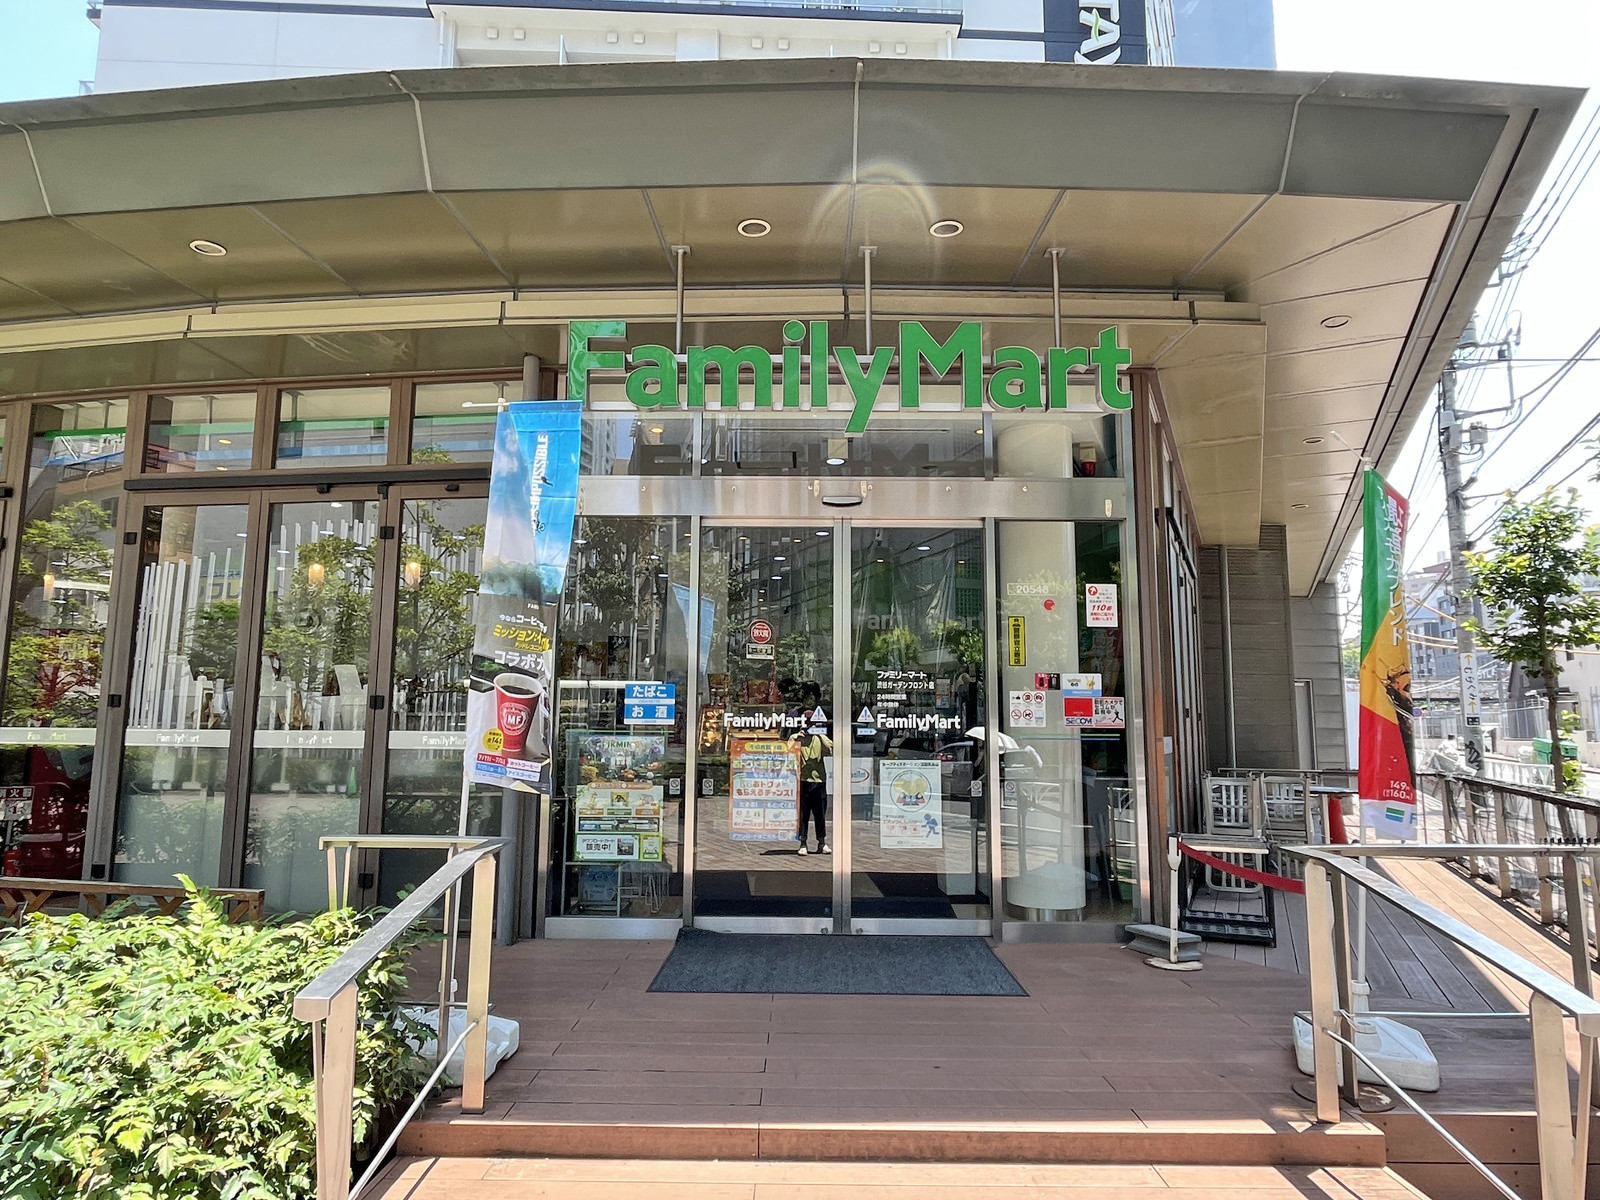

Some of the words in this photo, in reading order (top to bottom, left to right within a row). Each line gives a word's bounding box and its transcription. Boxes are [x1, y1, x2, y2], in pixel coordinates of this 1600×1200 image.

[568, 320, 1132, 434] FamilyMart
[877, 671, 927, 680] ファミリーマート
[632, 686, 668, 697] たばこ
[507, 714, 522, 725] MF
[724, 713, 807, 730] FamilyMart
[877, 714, 961, 730] FamilyMart
[1065, 717, 1093, 725] SECOM
